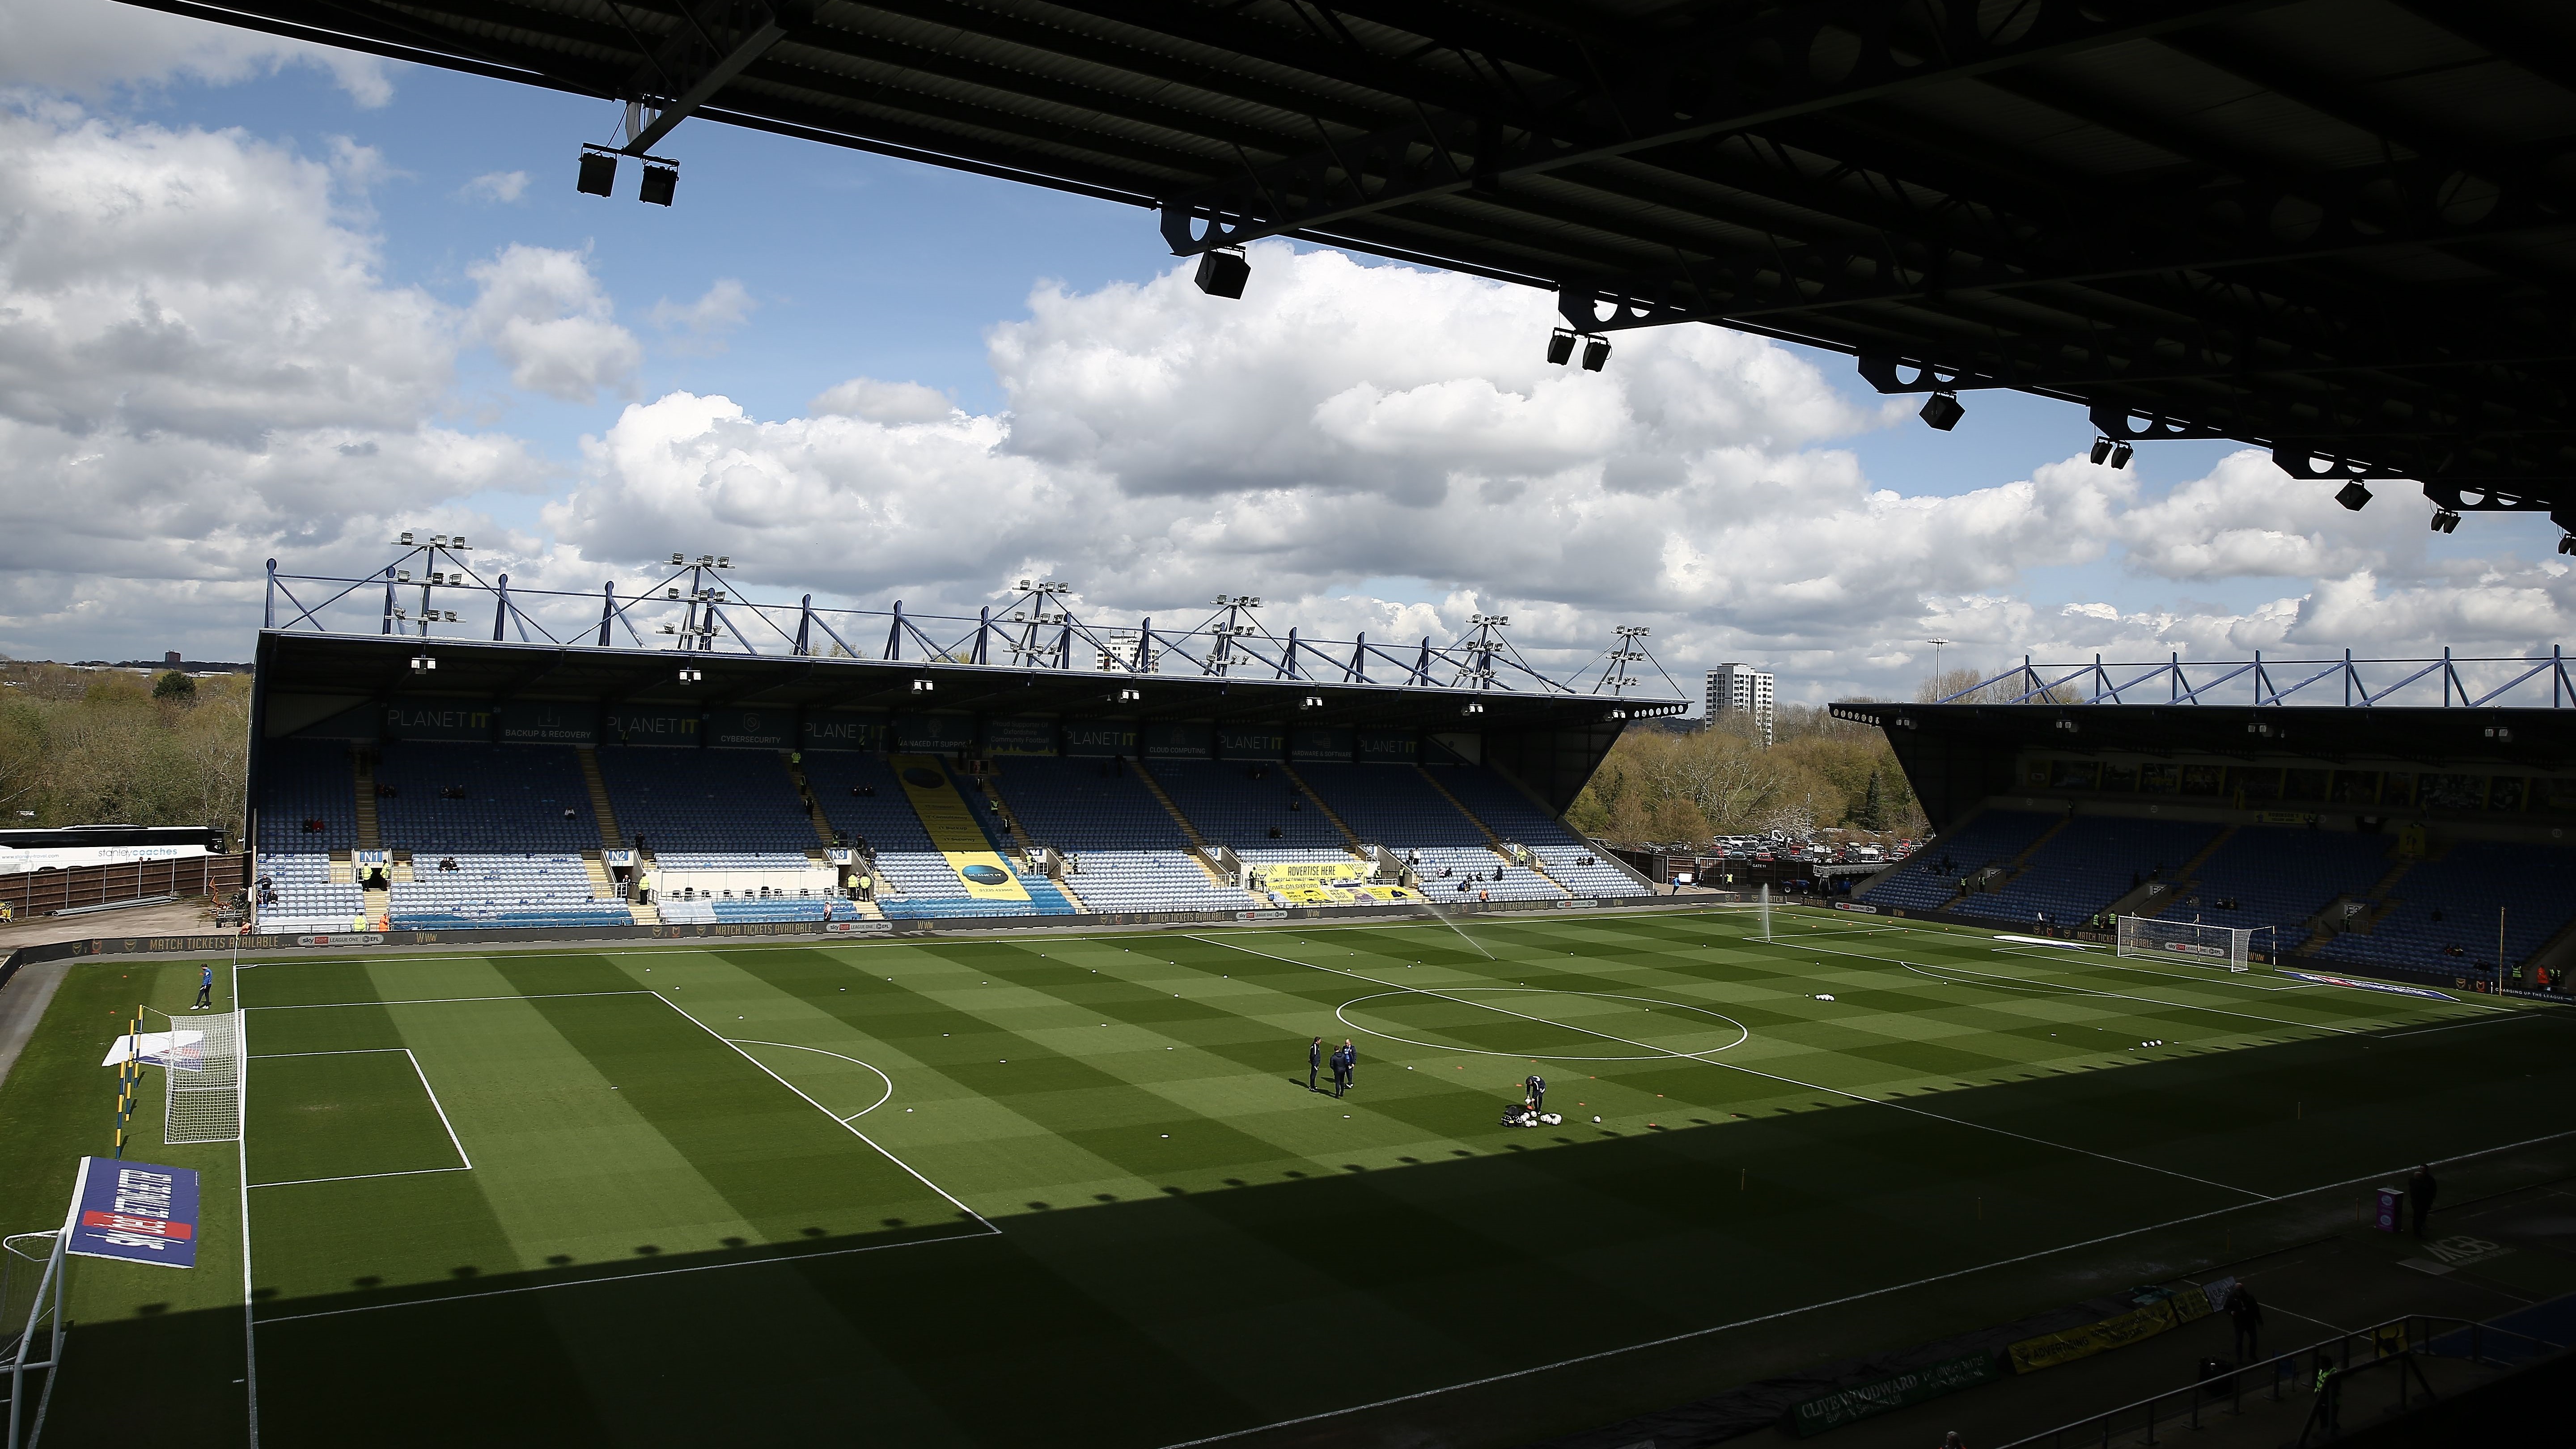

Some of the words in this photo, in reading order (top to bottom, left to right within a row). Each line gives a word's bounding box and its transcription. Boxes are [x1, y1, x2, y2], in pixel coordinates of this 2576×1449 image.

[388, 710, 467, 727] PLANET
[471, 712, 491, 728] IT
[681, 719, 699, 734] IT
[871, 725, 887, 741] IT
[549, 730, 591, 738] RECOVERY
[721, 736, 781, 744] CYBERSECURITY
[1123, 732, 1137, 746] IT
[1271, 737, 1285, 750] IT
[1405, 741, 1417, 754] IT
[364, 852, 378, 862] N1
[612, 851, 626, 860] N2
[832, 849, 845, 859] N3
[1288, 866, 1319, 876] ADVERTISE
[1321, 866, 1335, 876] HERE
[1488, 902, 1504, 911] MATCH
[1505, 902, 1524, 910] TICKETS
[1525, 901, 1548, 909] AVAILABLE
[1805, 898, 1827, 907] AVAILABLE
[1149, 914, 1169, 923] MATCH
[1169, 913, 1193, 922] TICKETS
[1196, 912, 1225, 921] AVAILABLE
[716, 925, 741, 935] MATCH
[743, 924, 772, 934] TICKETS
[775, 923, 812, 933] AVAILABLE
[150, 938, 183, 950] MATCH
[187, 937, 225, 949] TICKETS
[2077, 932, 2096, 941] MATCH
[2097, 933, 2117, 943] TICKET
[118, 1169, 172, 1194] BETTER
[114, 1188, 171, 1219] BETTING
[94, 1215, 166, 1234] bet
[86, 1229, 185, 1250] sky
[2421, 1236, 2500, 1262] MGB
[2033, 1336, 2089, 1359] ADVERTISING
[1802, 1396, 1840, 1419] CLIVE
[1838, 1374, 1918, 1406] WOODWARD
[1856, 1399, 1890, 1414] Services
[1889, 1393, 1902, 1405] Ltd
